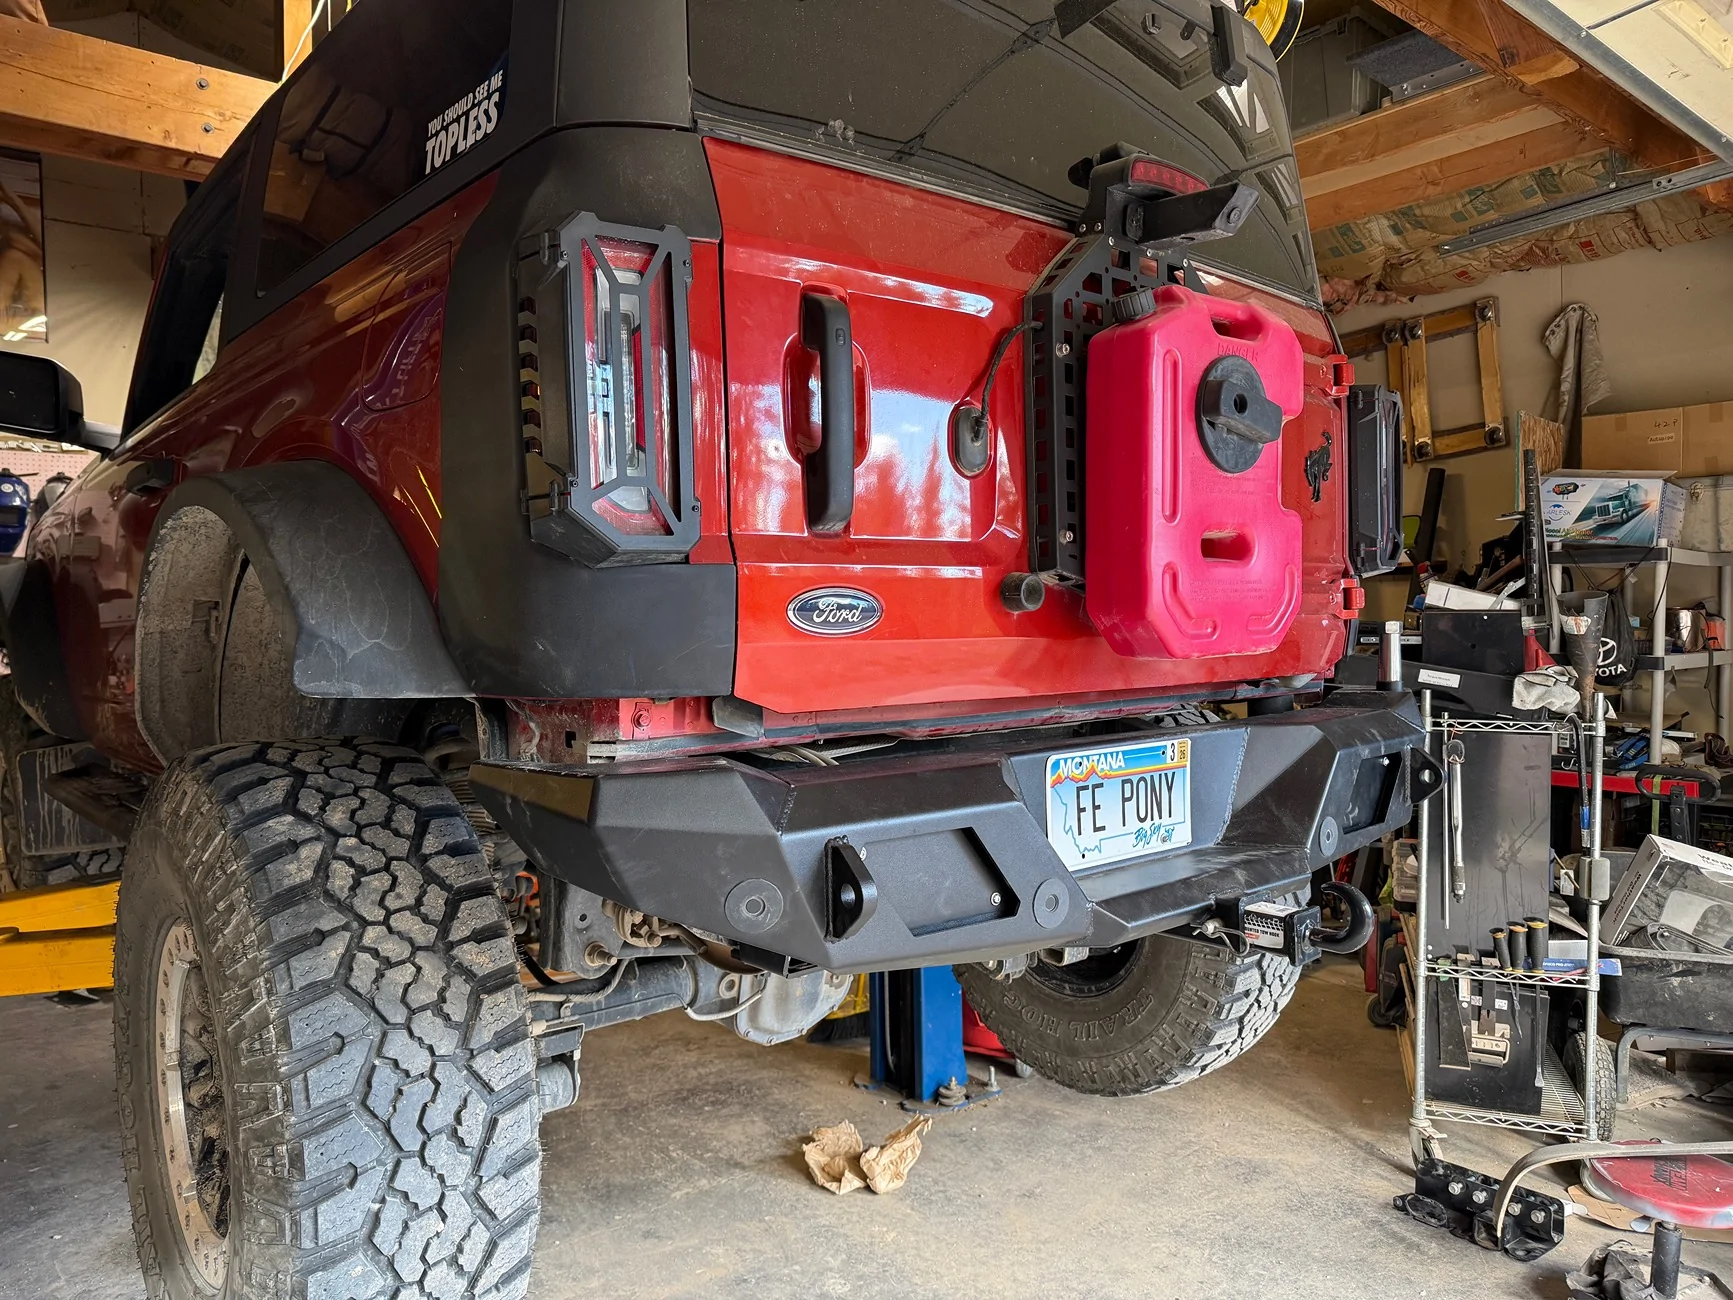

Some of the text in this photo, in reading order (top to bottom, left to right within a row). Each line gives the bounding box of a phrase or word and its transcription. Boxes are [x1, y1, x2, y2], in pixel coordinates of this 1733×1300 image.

[428, 69, 503, 137] YOU SHOULD SEE ME
[425, 91, 500, 175] TOPLESS
[812, 596, 863, 623] Ford
[1595, 663, 1628, 677] YOTA
[1060, 742, 1176, 775] MONTANA 3
[1179, 749, 1186, 760] 26
[1076, 771, 1176, 836] FE PONY
[1003, 987, 1153, 1041] TRAIL HOG
